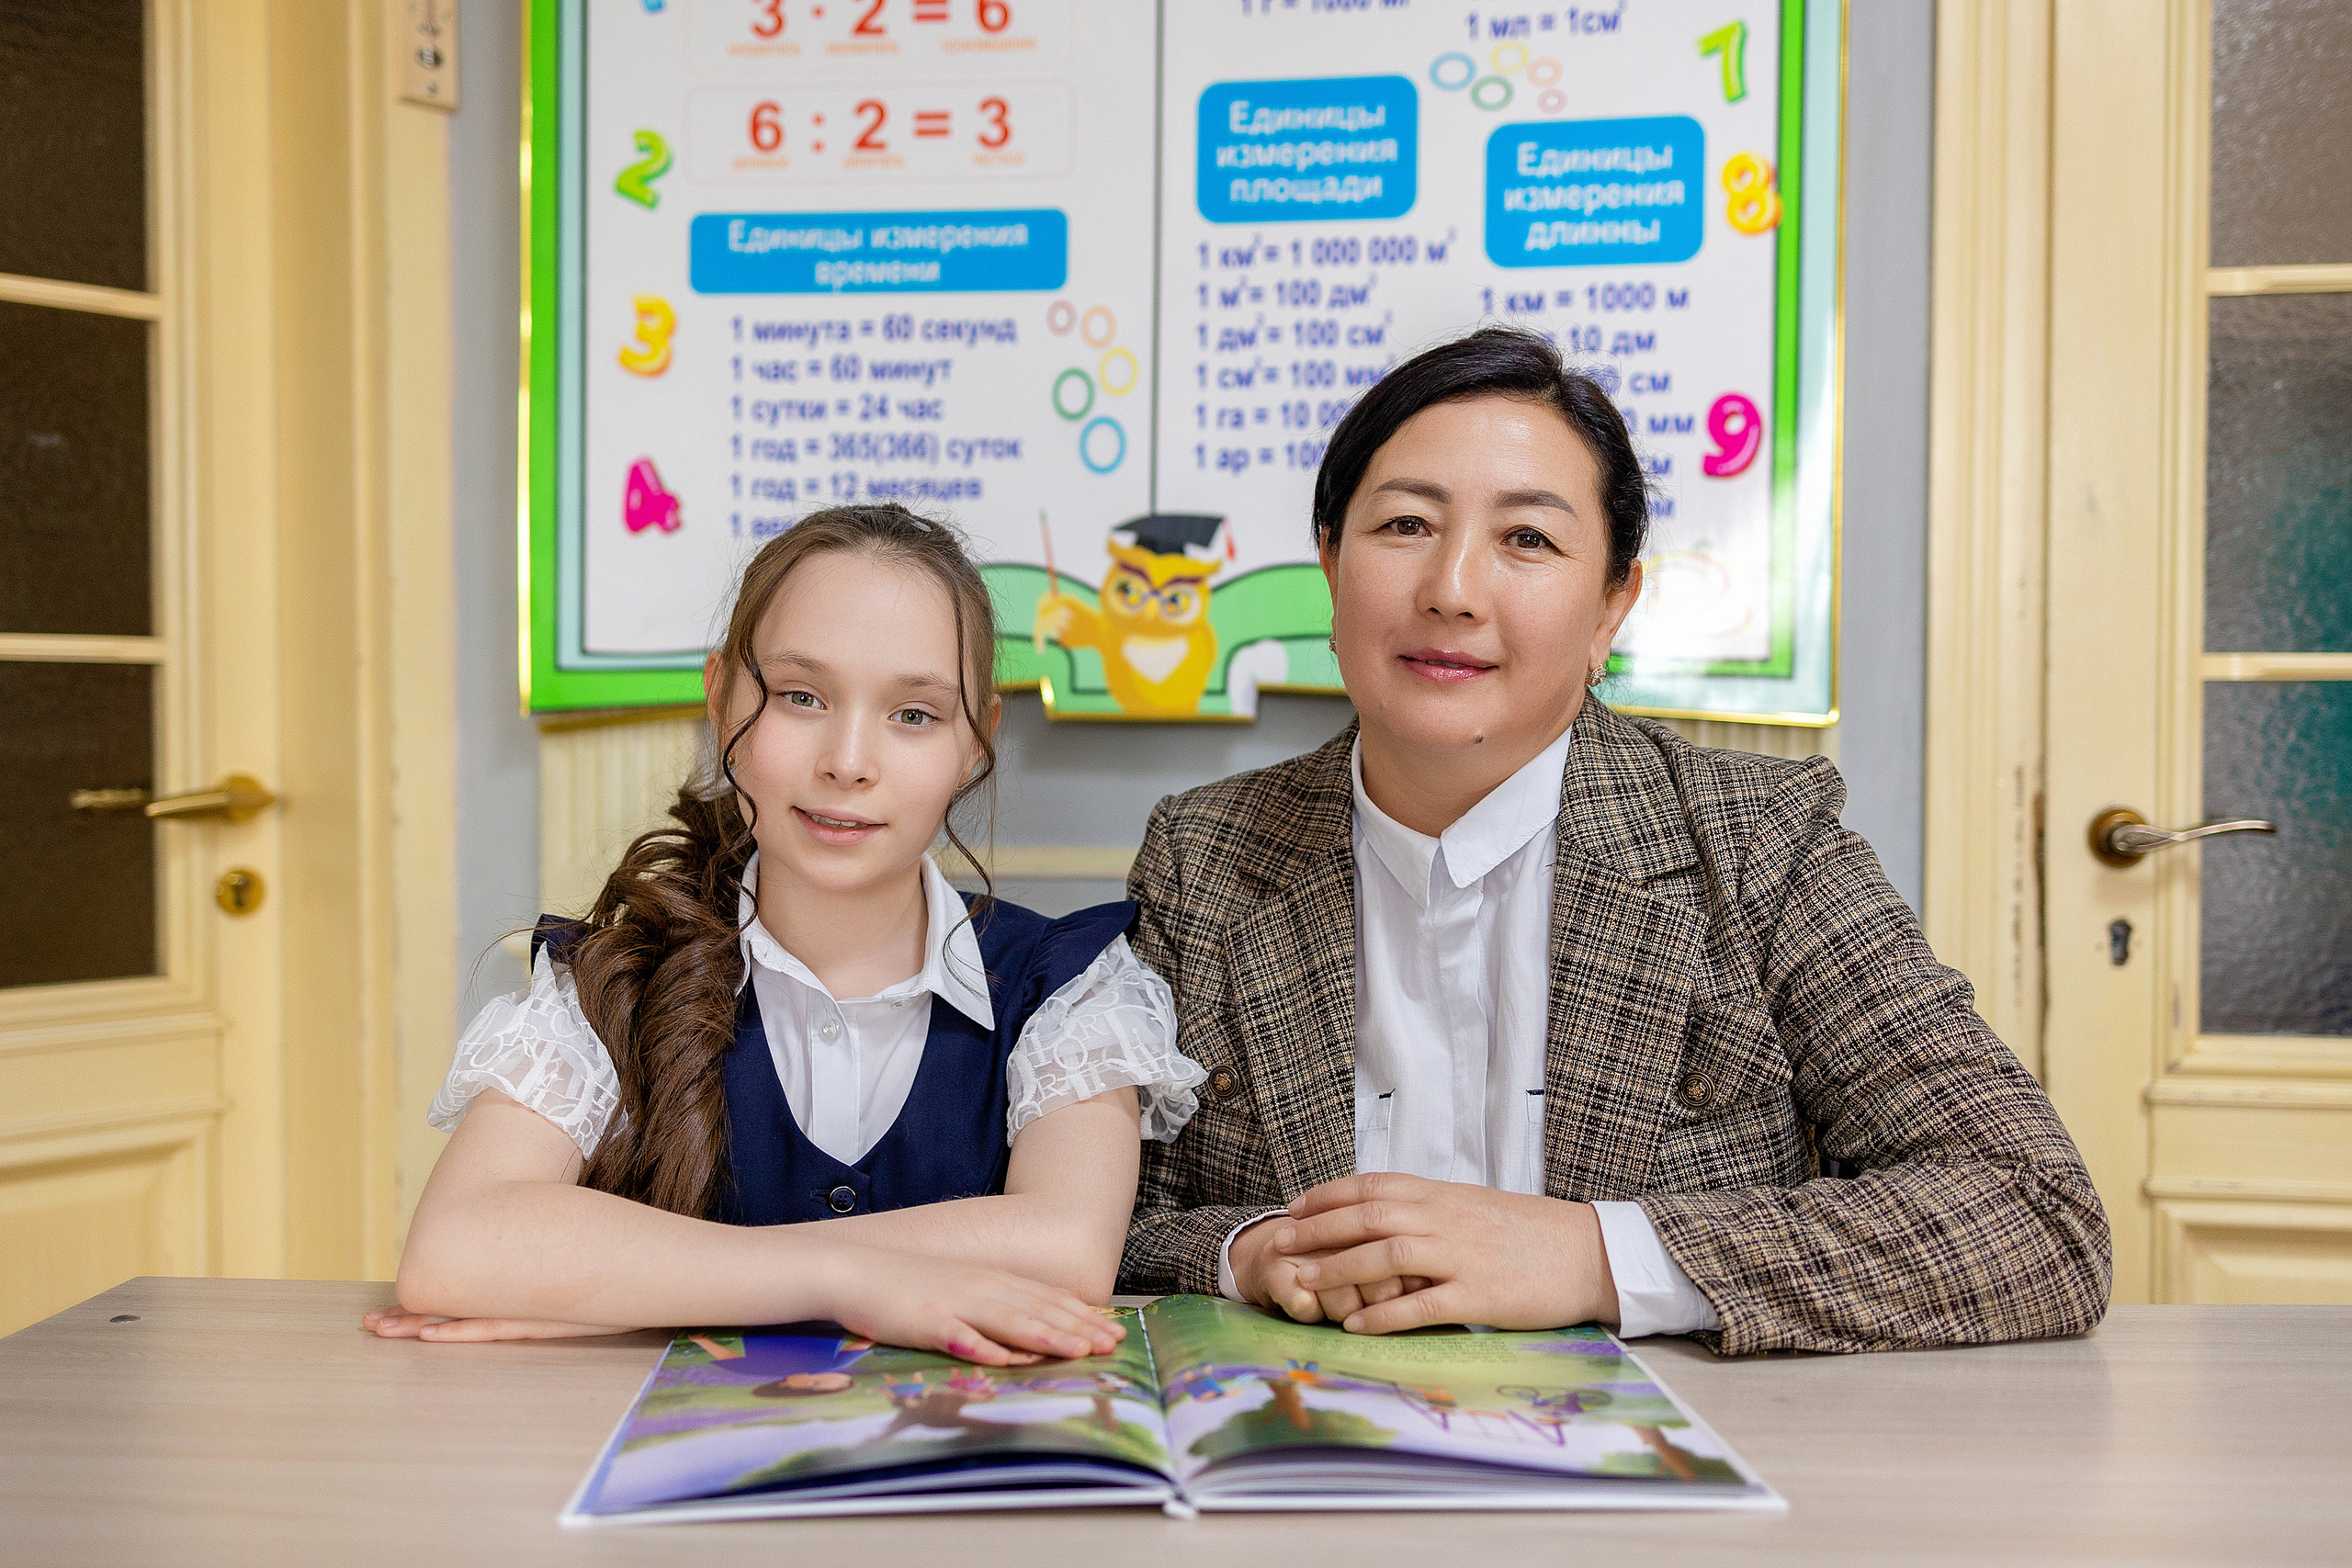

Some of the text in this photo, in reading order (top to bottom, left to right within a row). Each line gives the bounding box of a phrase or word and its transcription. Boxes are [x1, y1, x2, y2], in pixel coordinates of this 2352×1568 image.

[751, 0, 787, 39] 3
[851, 0, 888, 38] 2
[974, 0, 1012, 35] 6
[1694, 19, 1747, 103] 7
[746, 100, 786, 154] 6
[851, 98, 889, 153] 2
[912, 109, 952, 139] =
[976, 95, 1013, 152] 3
[1228, 99, 1385, 136] Единицы
[615, 129, 673, 211] 2
[1216, 137, 1398, 173] измерения
[1517, 141, 1672, 179] Единицы
[1229, 175, 1383, 205] площади
[1503, 179, 1686, 218] измерения
[1721, 151, 1784, 236] 8
[728, 219, 1030, 254] Единицы измерения
[1195, 241, 1212, 269] 1
[1288, 239, 1304, 266] 1
[1309, 235, 1363, 268] 000
[1366, 233, 1419, 266] 000
[814, 259, 941, 293] времени
[1195, 281, 1210, 309] 1
[1273, 276, 1323, 310] 100
[1479, 286, 1496, 316] 1
[1503, 291, 1547, 315] км
[1583, 279, 1658, 314] 1000
[1664, 286, 1691, 311] м
[618, 292, 677, 378] 3
[729, 315, 744, 341] 1
[751, 319, 854, 349] минута
[880, 312, 915, 343] 60
[920, 317, 1019, 348] секунд
[1195, 321, 1210, 350] 1
[1291, 318, 1341, 350] 100
[1566, 322, 1604, 356] 10
[1607, 329, 1658, 359] дм
[729, 355, 744, 380] 1
[752, 359, 798, 383] час
[828, 353, 863, 383] 60
[867, 357, 954, 389] минут
[1194, 361, 1209, 389] 1
[1288, 357, 1339, 390] 100
[1627, 370, 1674, 398] см
[729, 394, 744, 420] 1
[750, 398, 830, 428] сутки
[857, 391, 891, 423] 24
[896, 398, 944, 423] час
[1193, 401, 1209, 430] 1
[1215, 406, 1248, 432] га
[1278, 399, 1311, 432] 10
[1645, 412, 1698, 437] мм
[729, 433, 744, 458] 1
[750, 437, 799, 465] год
[829, 429, 941, 465] 365(366)
[944, 436, 1023, 468] суток
[1702, 392, 1762, 479] 9
[1193, 442, 1208, 470] 1
[1214, 446, 1253, 478] ар
[623, 456, 683, 535] 4
[729, 472, 744, 499] 1
[750, 477, 799, 504] год
[829, 469, 860, 502] 12
[865, 477, 984, 504] месяцев
[729, 511, 743, 537] 1
